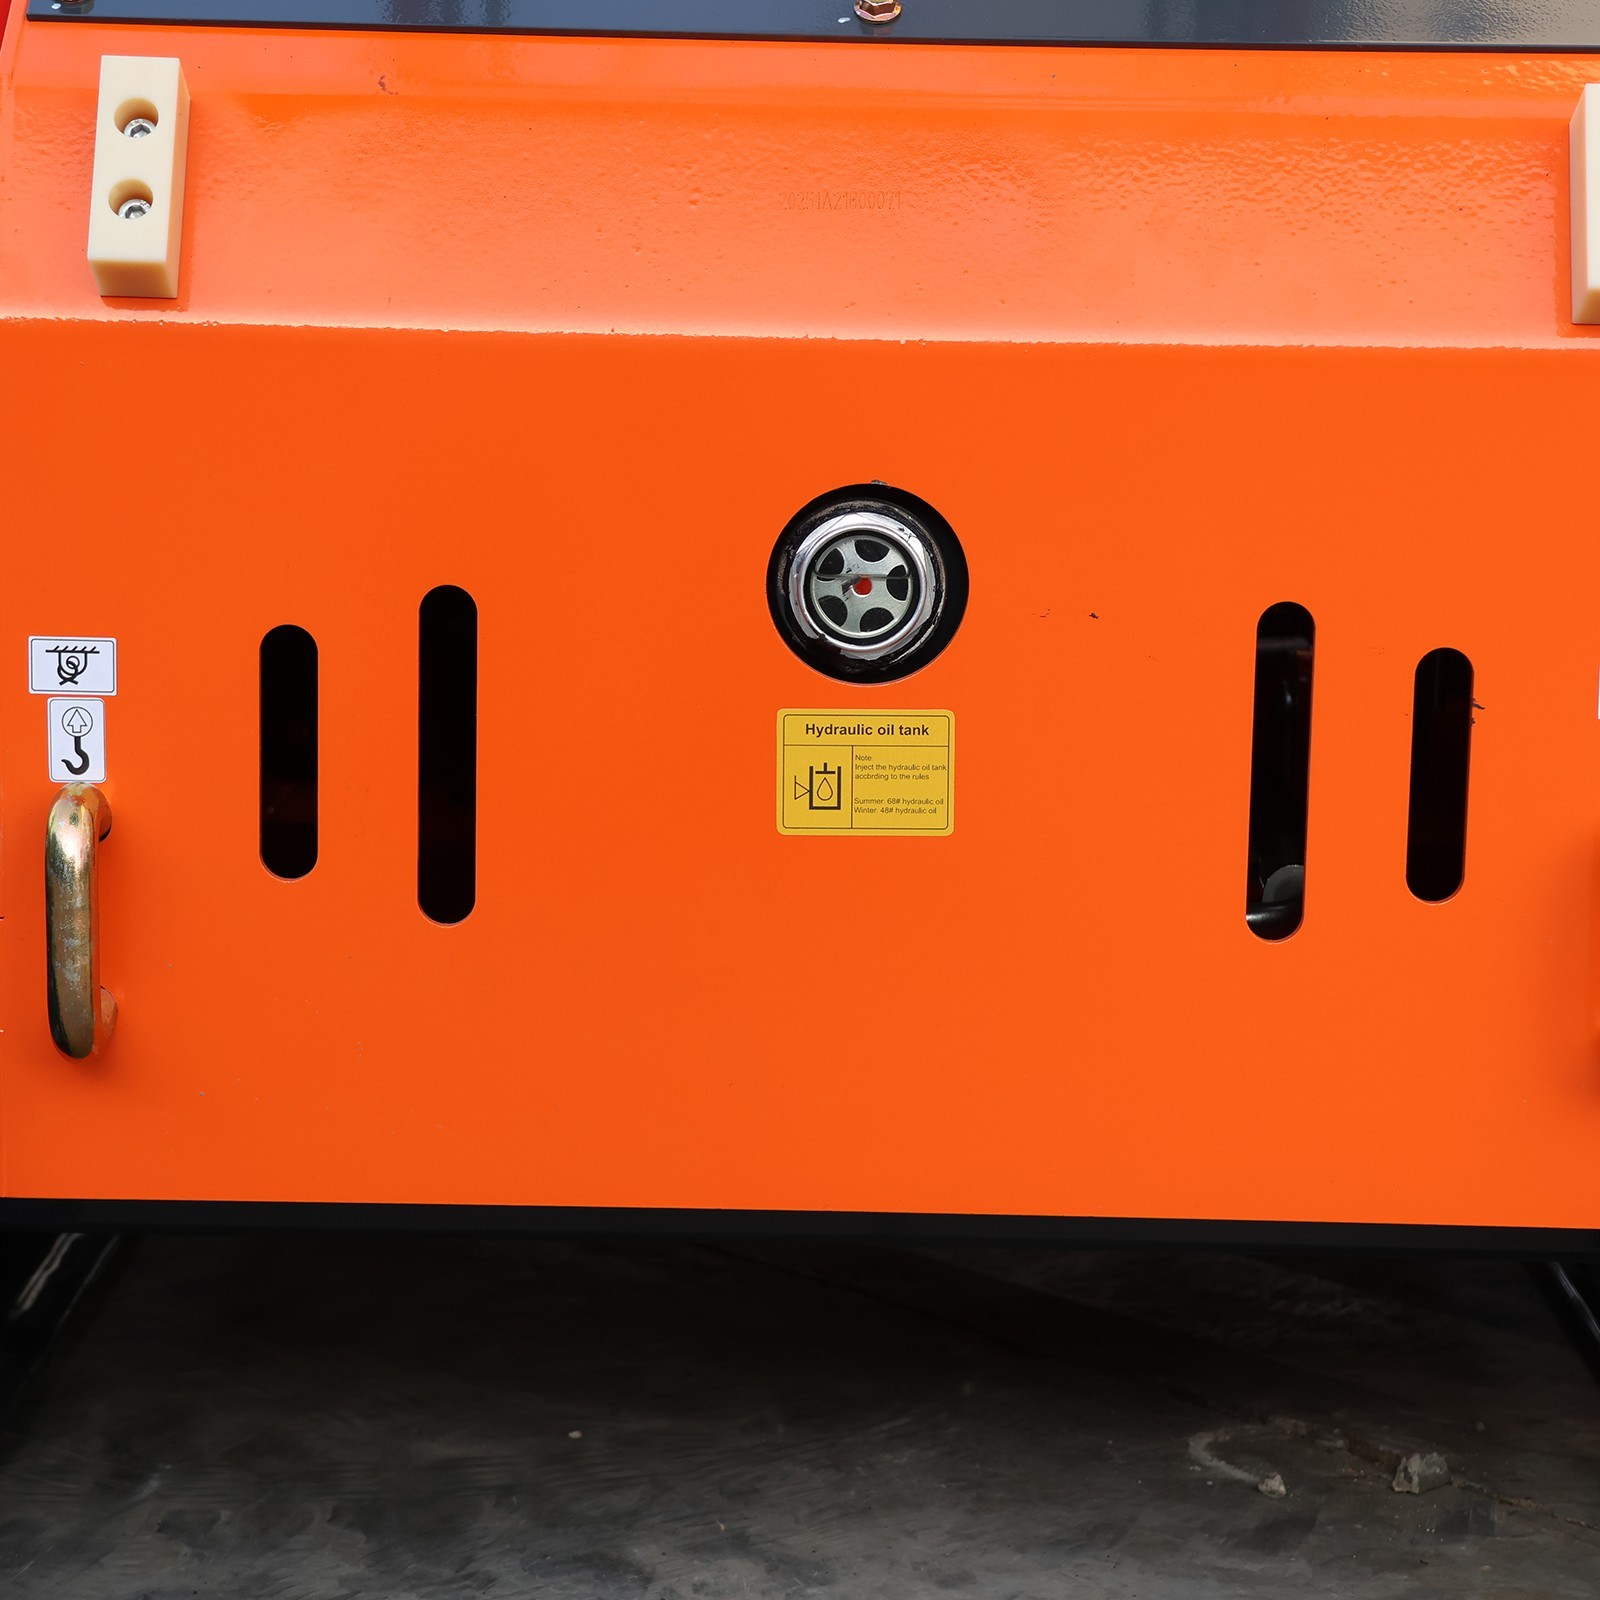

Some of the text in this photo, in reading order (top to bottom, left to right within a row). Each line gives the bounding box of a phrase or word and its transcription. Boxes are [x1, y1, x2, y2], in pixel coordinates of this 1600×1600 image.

[805, 723, 930, 737] Hydraulic oil tank
[855, 763, 875, 772] Inject
[888, 763, 921, 772] hydraulic
[887, 797, 901, 805] 68#
[902, 798, 934, 806] hydraulic
[895, 807, 927, 815] hydraulic
